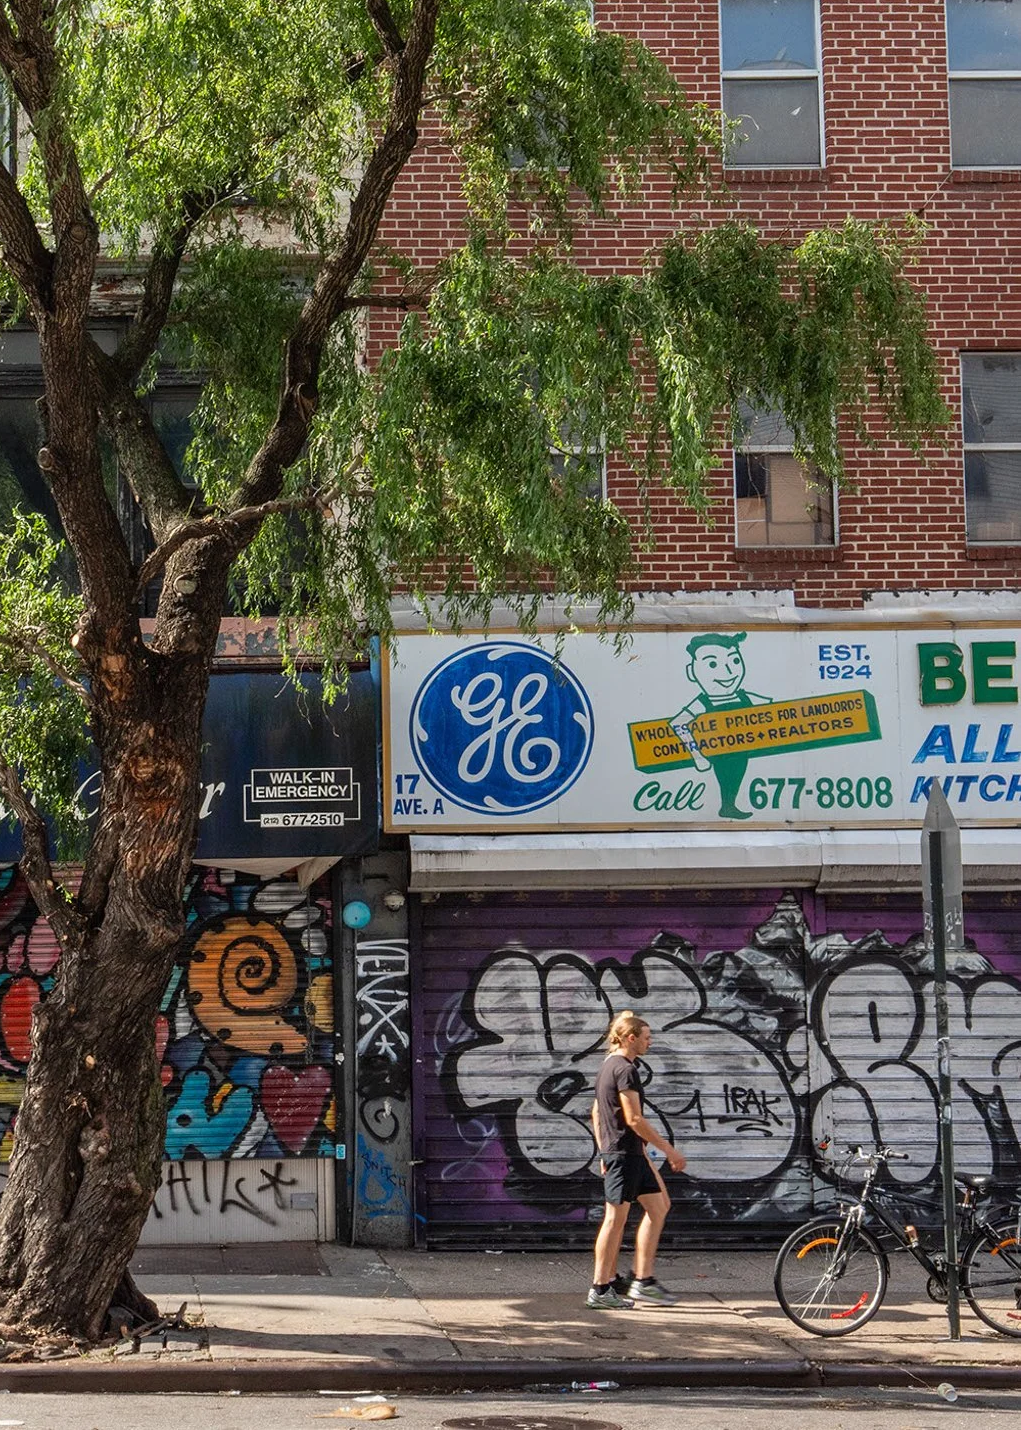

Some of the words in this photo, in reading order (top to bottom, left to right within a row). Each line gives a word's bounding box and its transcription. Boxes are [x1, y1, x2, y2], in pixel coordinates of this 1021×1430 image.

[818, 644, 870, 661] EST.
[818, 665, 872, 680] 1924
[916, 641, 1019, 706] BE
[451, 672, 561, 783] GE
[635, 719, 718, 742] WHOLESALE
[725, 711, 772, 729] PRICES
[777, 708, 797, 721] FOR
[801, 698, 863, 717] LANDLORDS
[653, 732, 756, 758] CONTRACTORS
[768, 717, 854, 740] REALTORS
[912, 724, 1021, 764] ALL
[269, 771, 335, 784] WALK-IN
[395, 774, 420, 795] 17
[255, 784, 348, 799] EMERGENCY
[633, 779, 706, 812] Call
[748, 776, 894, 809] 677-8808
[393, 798, 428, 815] AVE.
[432, 798, 445, 815] A
[263, 817, 279, 825] (212)
[282, 814, 341, 826] 677-2510
